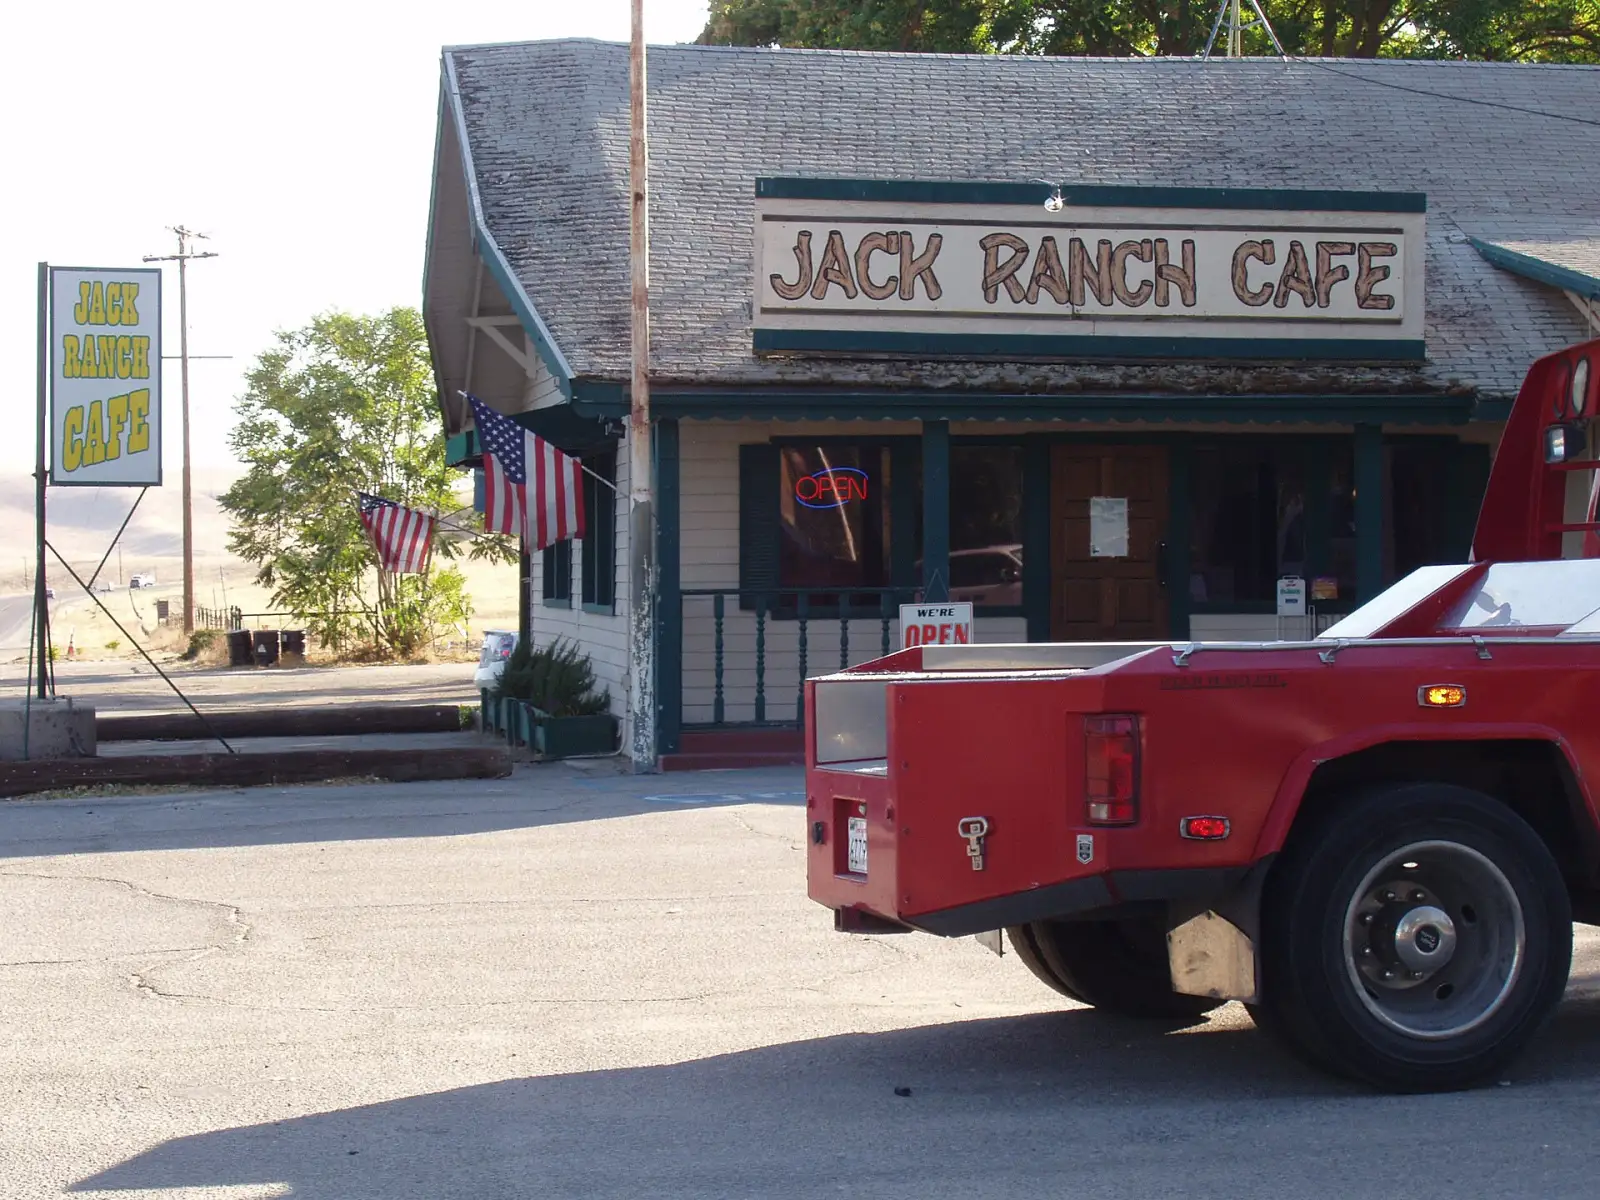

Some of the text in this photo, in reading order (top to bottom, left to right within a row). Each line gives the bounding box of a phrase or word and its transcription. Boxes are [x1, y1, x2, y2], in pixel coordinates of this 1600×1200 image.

[769, 229, 1397, 310] JACK RANCH CAFE
[74, 281, 139, 326] JACK
[63, 334, 150, 379] RANCH
[62, 388, 150, 472] CAFE
[795, 475, 868, 500] OPEN
[905, 622, 970, 648] OPEN
[917, 607, 956, 618] WE'RE
